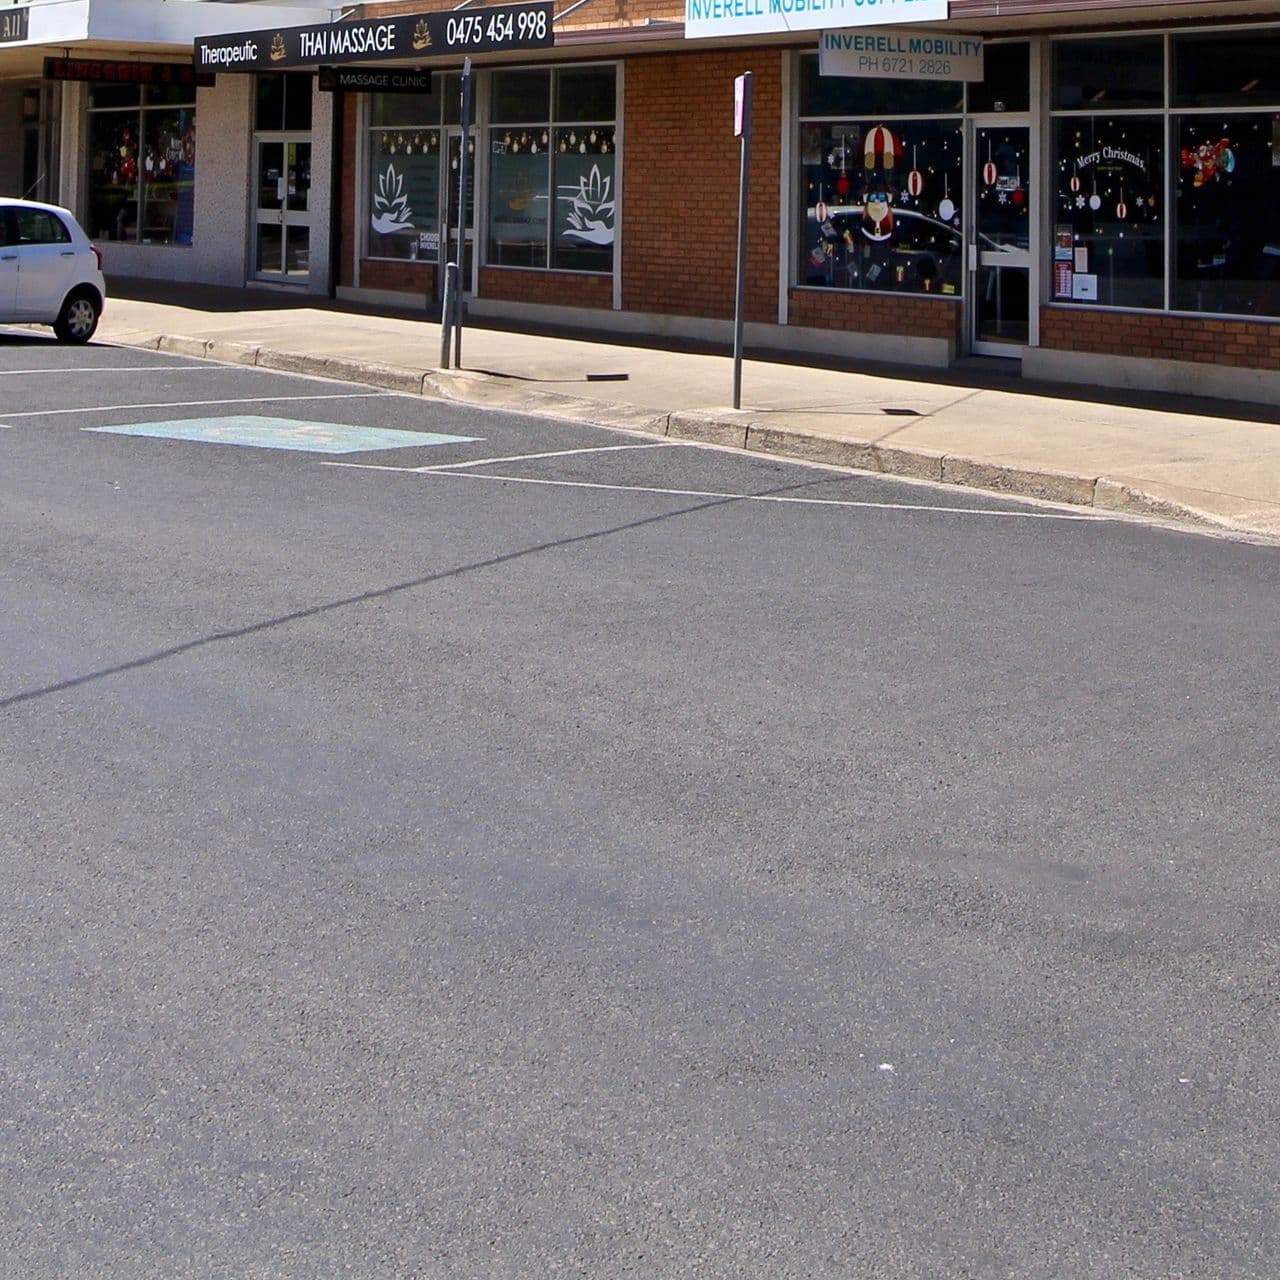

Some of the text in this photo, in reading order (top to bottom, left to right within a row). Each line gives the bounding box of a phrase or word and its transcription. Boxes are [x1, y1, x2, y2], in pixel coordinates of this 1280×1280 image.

[200, 10, 547, 67] Therapeutic THAI MASSAGE 0475 454 998
[825, 33, 982, 57] INVERELL MOBILITY
[858, 55, 951, 75] PH 6721 2826
[340, 74, 427, 87] MASSAGE CLINIC
[1076, 145, 1144, 169] Merry Christmas
